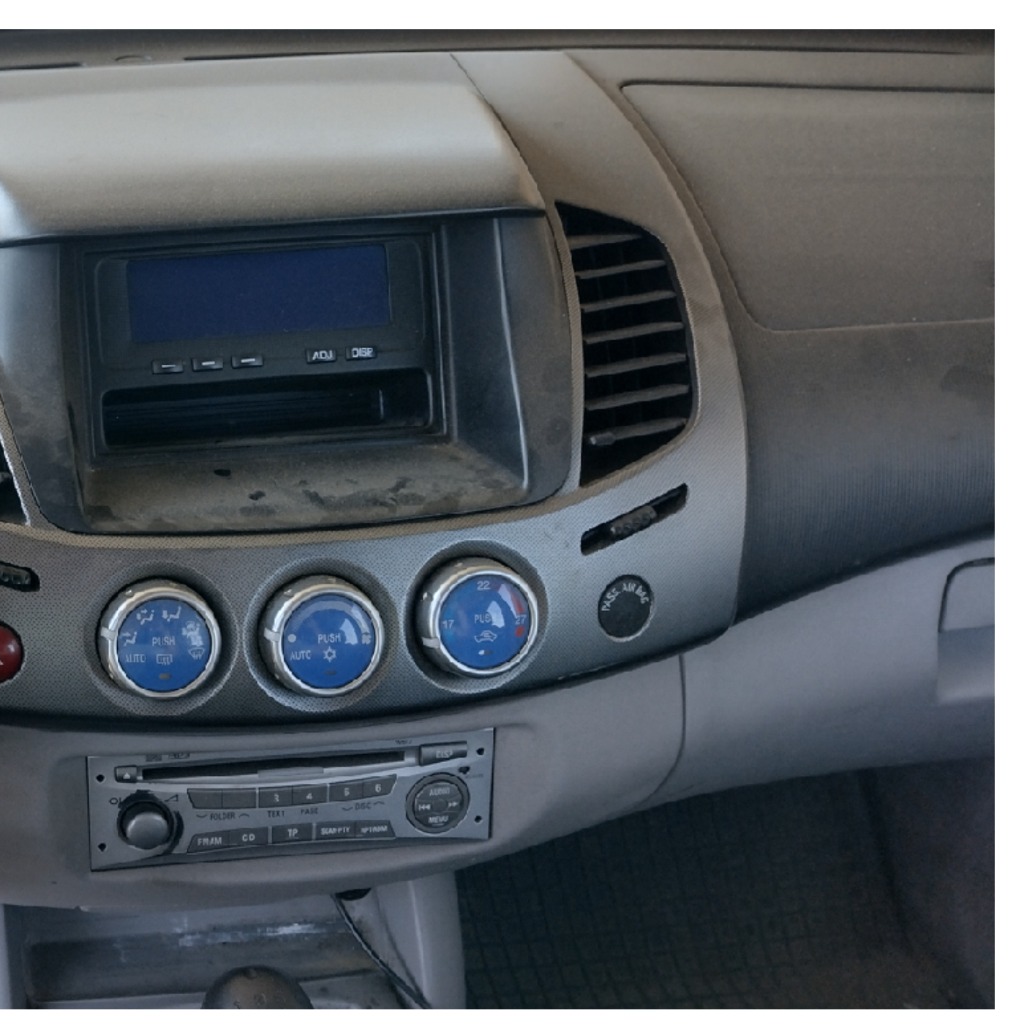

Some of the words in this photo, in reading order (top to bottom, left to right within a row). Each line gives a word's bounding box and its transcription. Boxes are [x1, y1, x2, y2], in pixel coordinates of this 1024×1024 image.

[312, 350, 334, 360] ADJ
[477, 580, 491, 591] 22
[442, 619, 455, 629] 17
[515, 614, 527, 625] 27
[151, 635, 176, 647] PUSH
[317, 632, 342, 644] PUSH
[241, 832, 255, 842] CD
